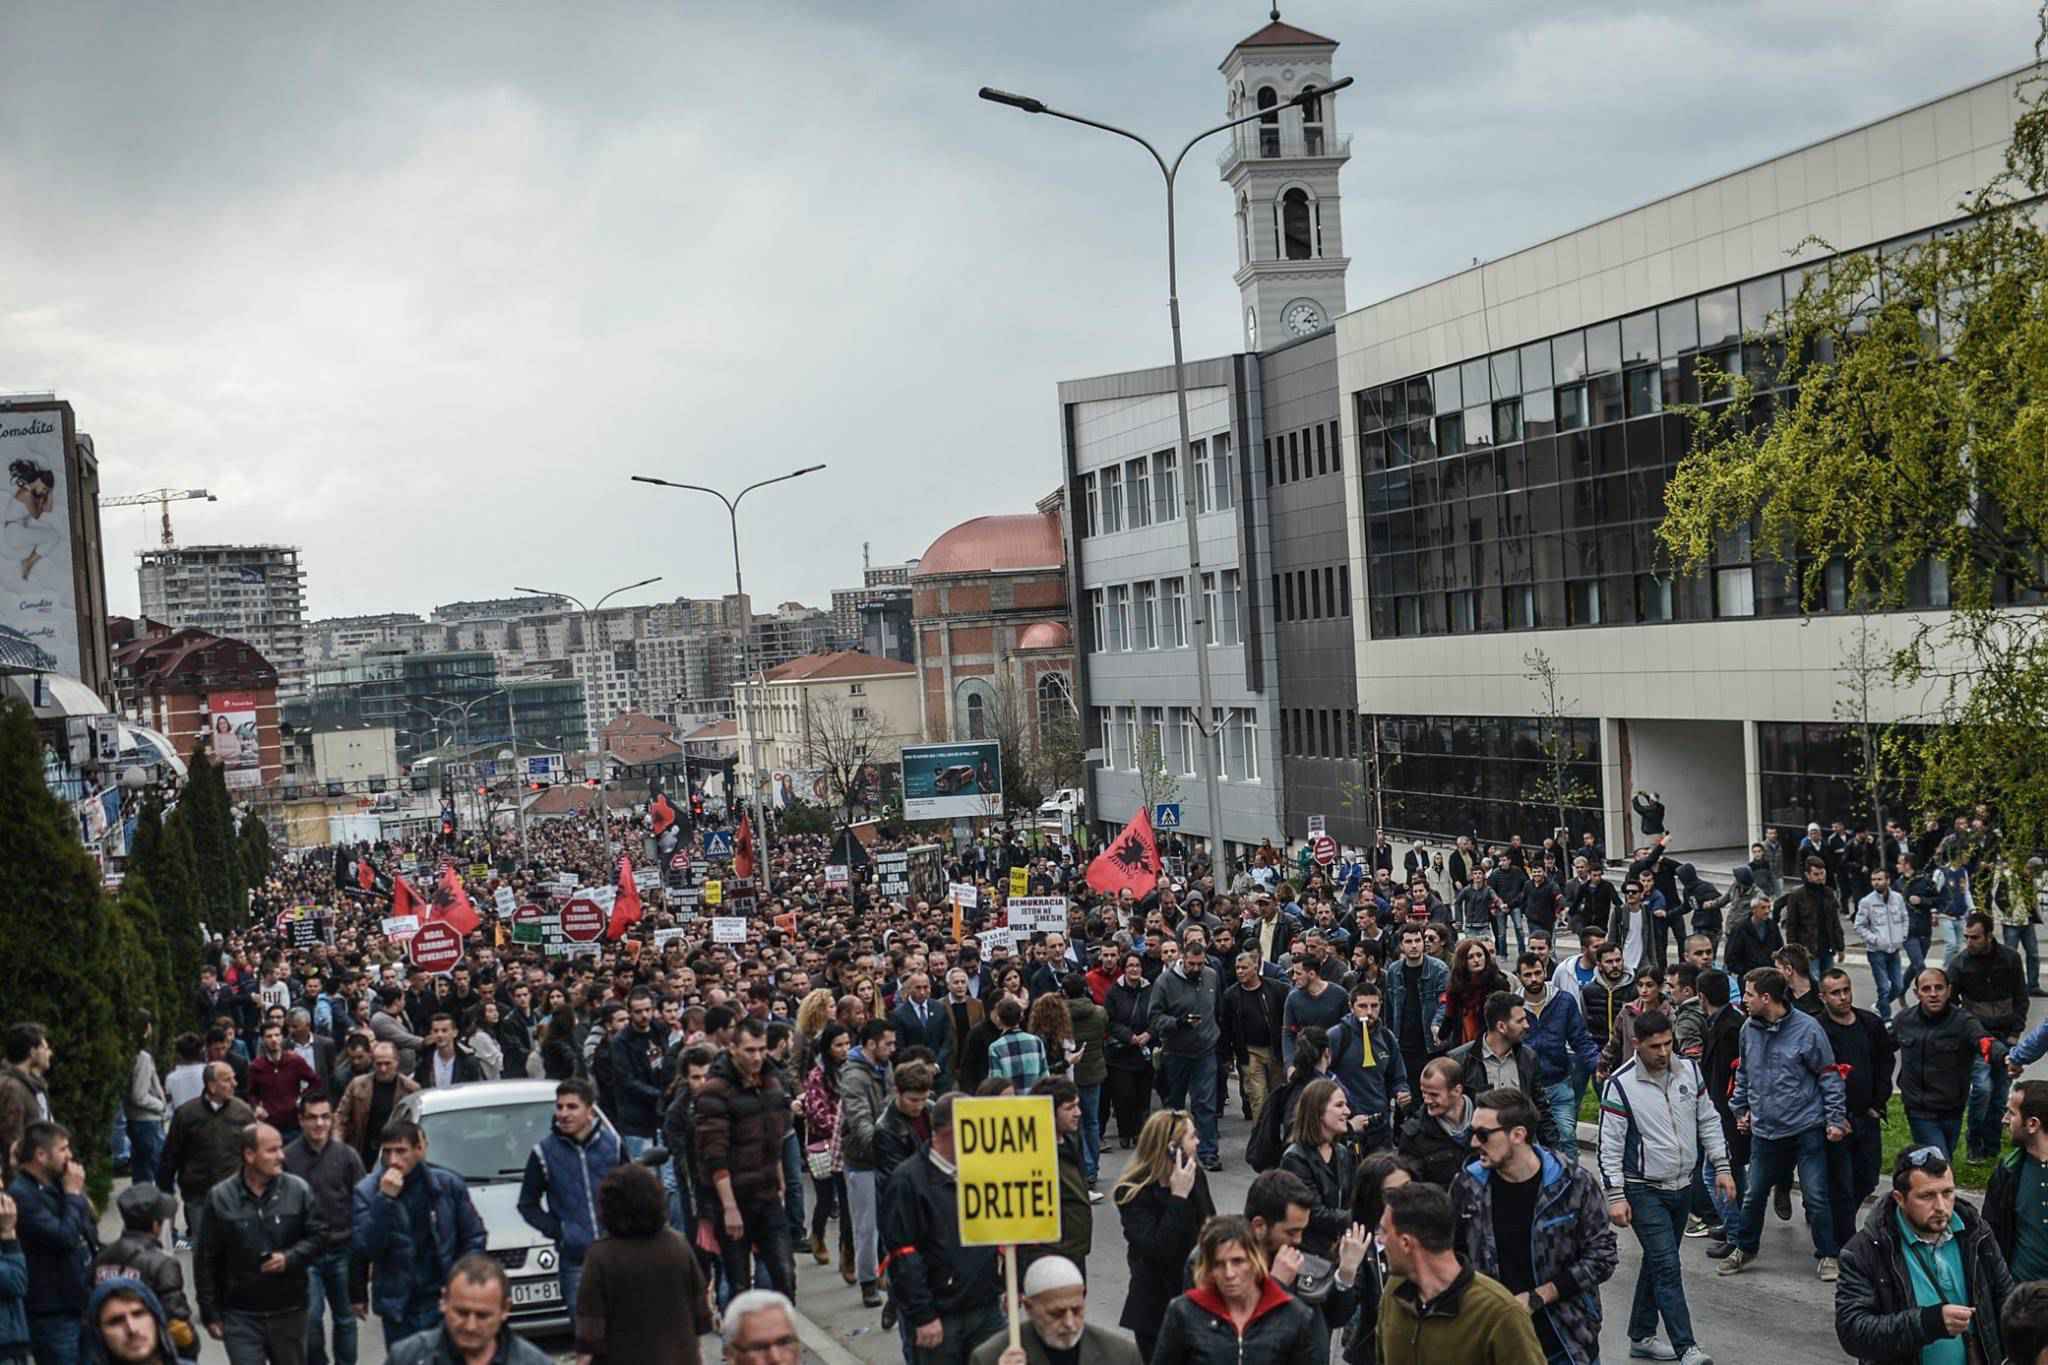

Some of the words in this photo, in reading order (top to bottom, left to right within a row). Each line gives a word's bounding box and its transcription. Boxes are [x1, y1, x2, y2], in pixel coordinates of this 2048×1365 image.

[0, 418, 55, 438] omodita
[961, 1116, 1037, 1154] DUAM
[964, 1169, 1054, 1220] DRITË!
